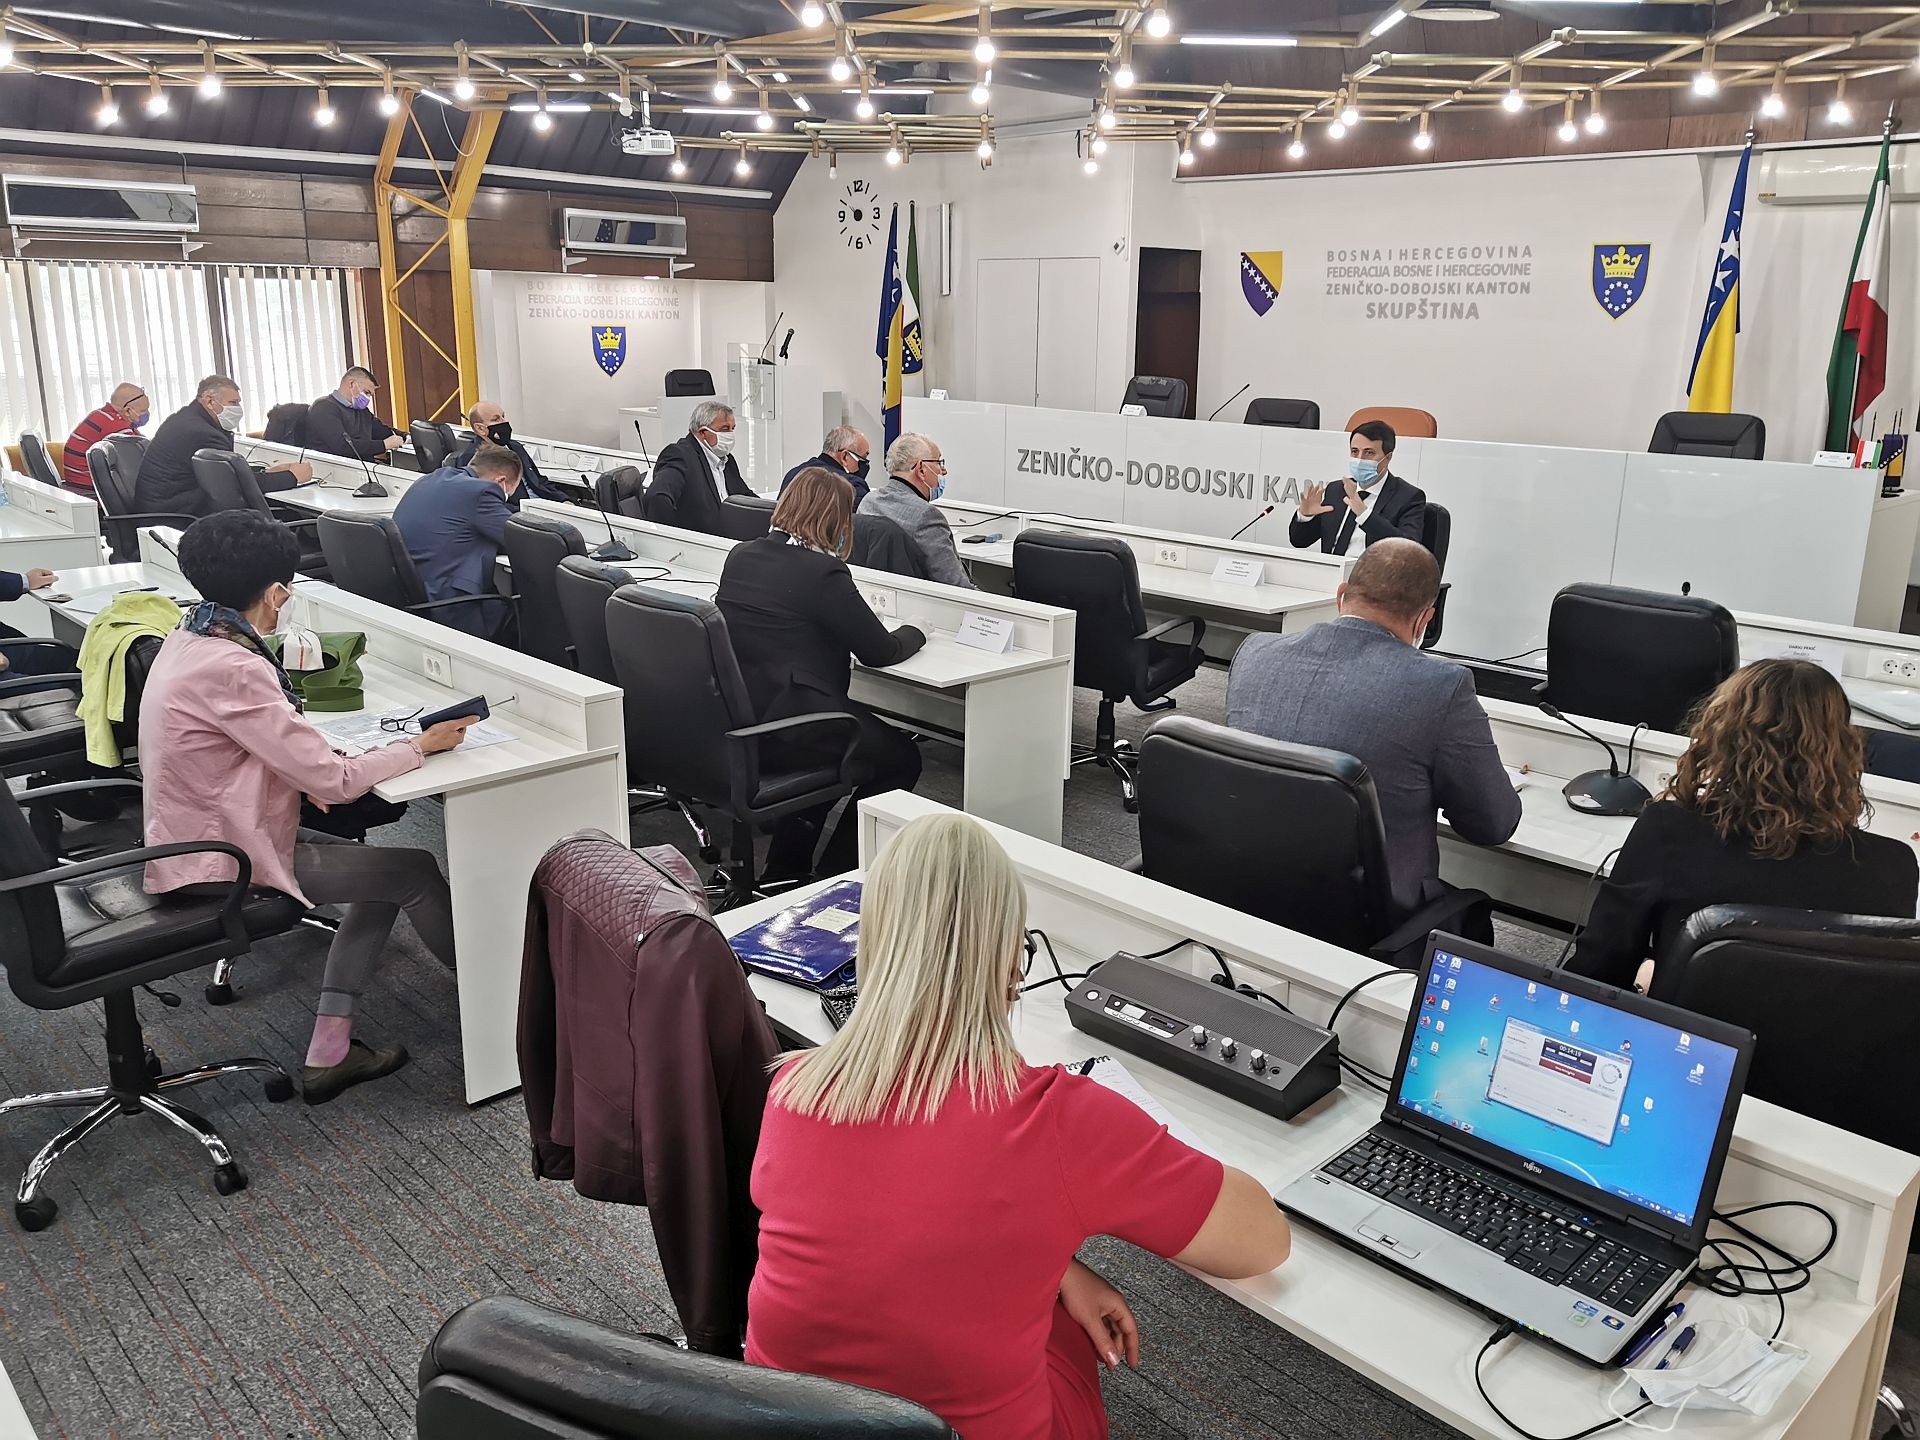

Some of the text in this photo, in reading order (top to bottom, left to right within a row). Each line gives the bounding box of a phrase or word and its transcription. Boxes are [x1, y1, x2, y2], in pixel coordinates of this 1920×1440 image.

[853, 180, 863, 192] 12
[838, 210, 845, 222] 9
[873, 207, 880, 219] 3
[856, 237, 863, 249] 6
[1327, 245, 1533, 262] BOSNA I HERCEGOVINA
[1326, 263, 1532, 278] FEDERACIJA BOSNE I HERCEGOVINE
[527, 280, 574, 292] BOSNA
[588, 283, 679, 295] HERCEGOVINA
[1326, 280, 1531, 296] ZENIČKO-DOBOJSKI KANTON
[528, 294, 582, 305] FEDERACIJA
[584, 295, 614, 306] BOSNE
[620, 296, 680, 307] HERCEGOVINE
[528, 307, 680, 320] ZENIČKO-DOBOJSKI KANTON
[1366, 298, 1480, 320] SKUPŠTINA
[1016, 446, 1255, 500] ZENIČKO-DOBOJSKI
[1559, 1044, 1582, 1057] 00:14:19
[1523, 1162, 1543, 1174] FUJITSU
